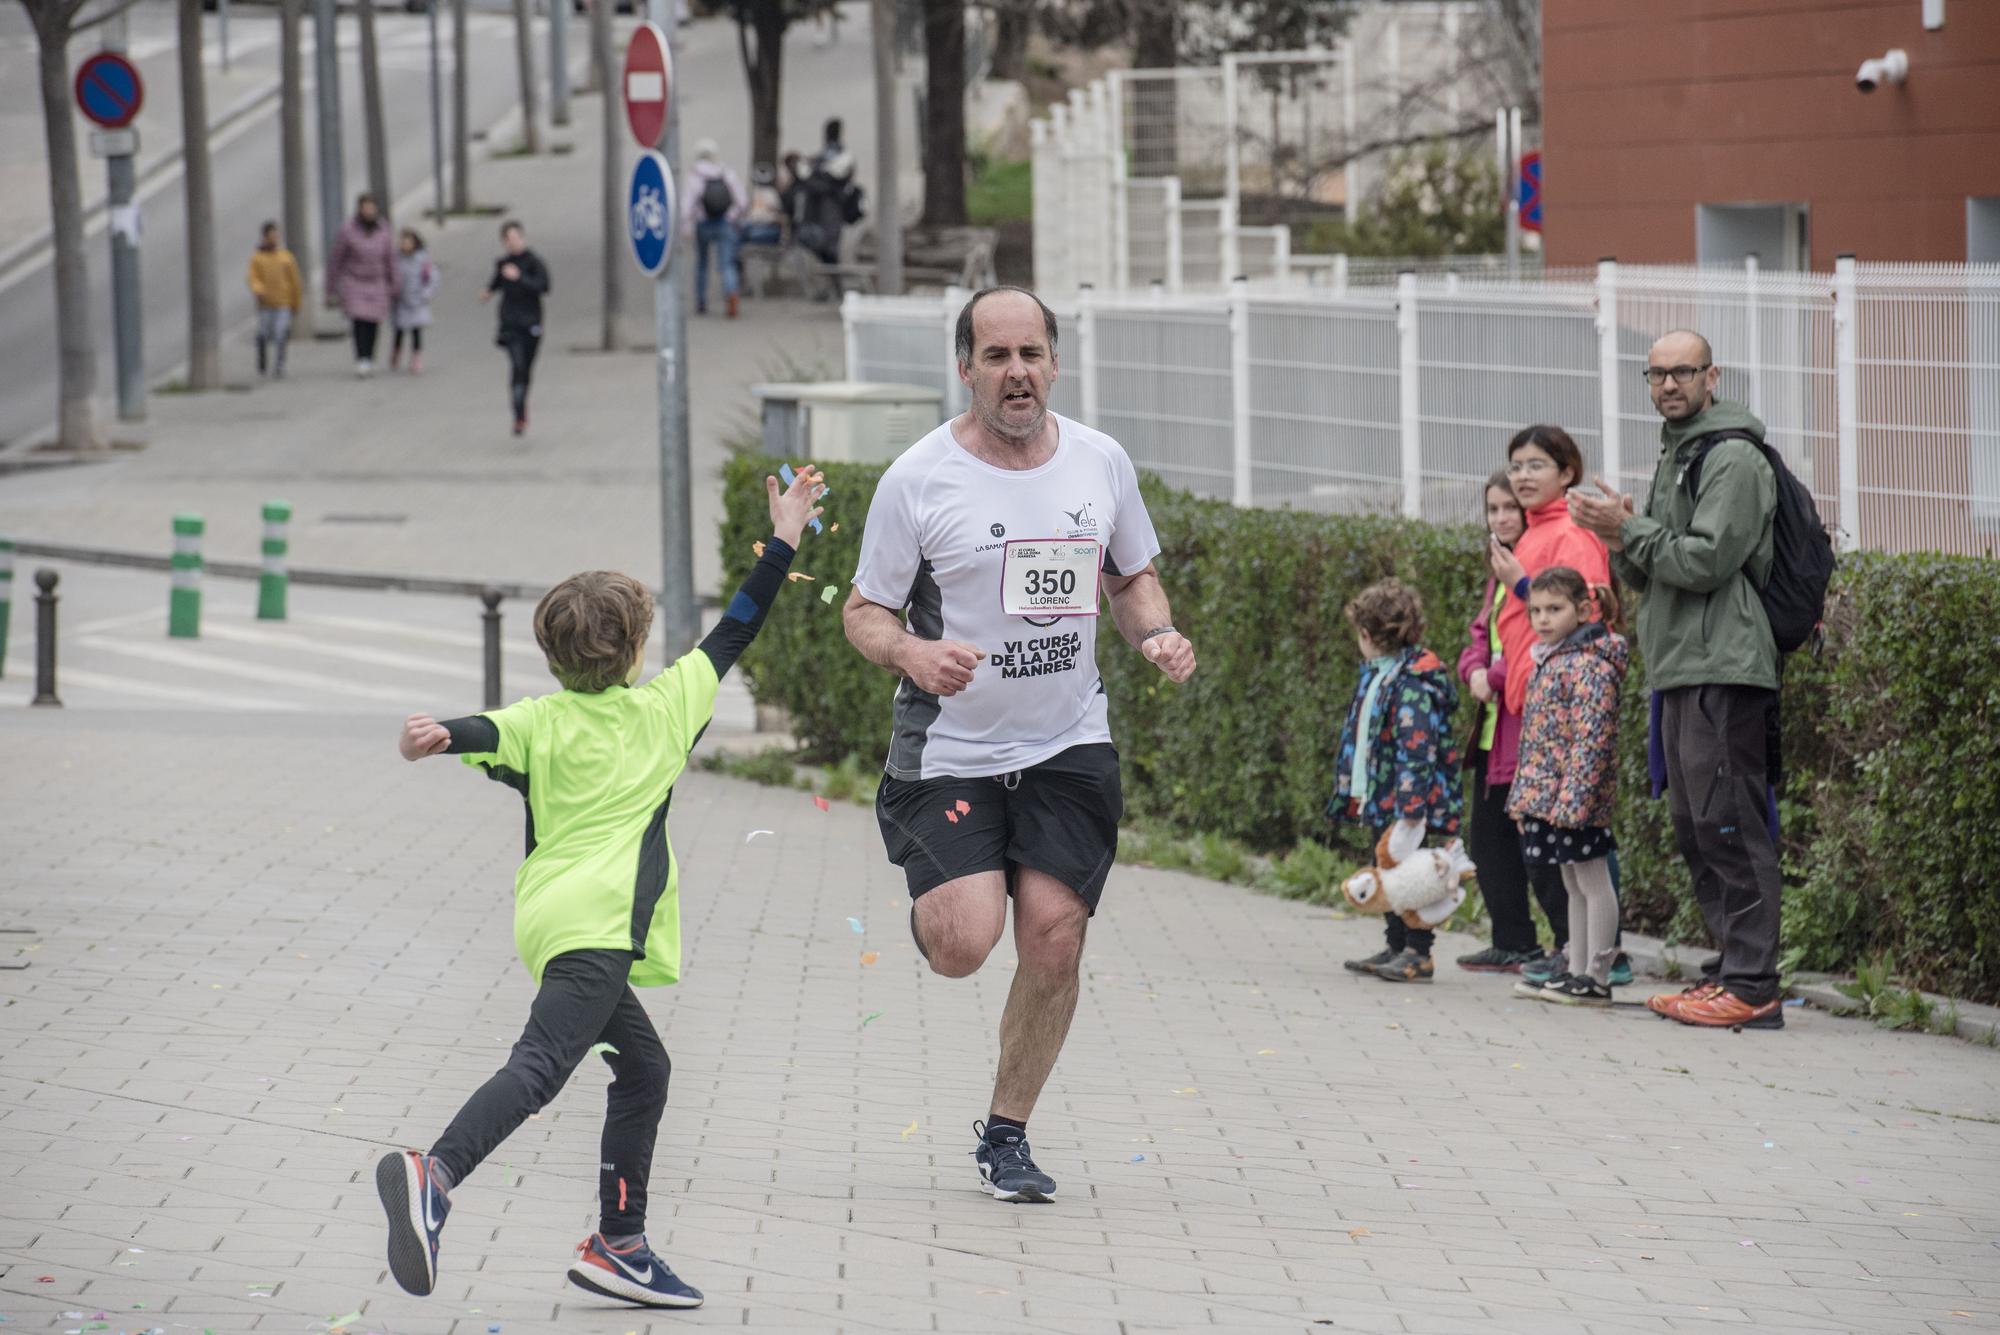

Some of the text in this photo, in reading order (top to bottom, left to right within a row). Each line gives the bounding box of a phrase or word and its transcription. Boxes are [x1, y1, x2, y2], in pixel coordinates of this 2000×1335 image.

[1024, 569, 1076, 595] 350
[1030, 597, 1070, 605] LLORENC
[1004, 631, 1079, 654] VI CURSA
[991, 654, 1016, 667] DE
[1020, 652, 1043, 666] LA
